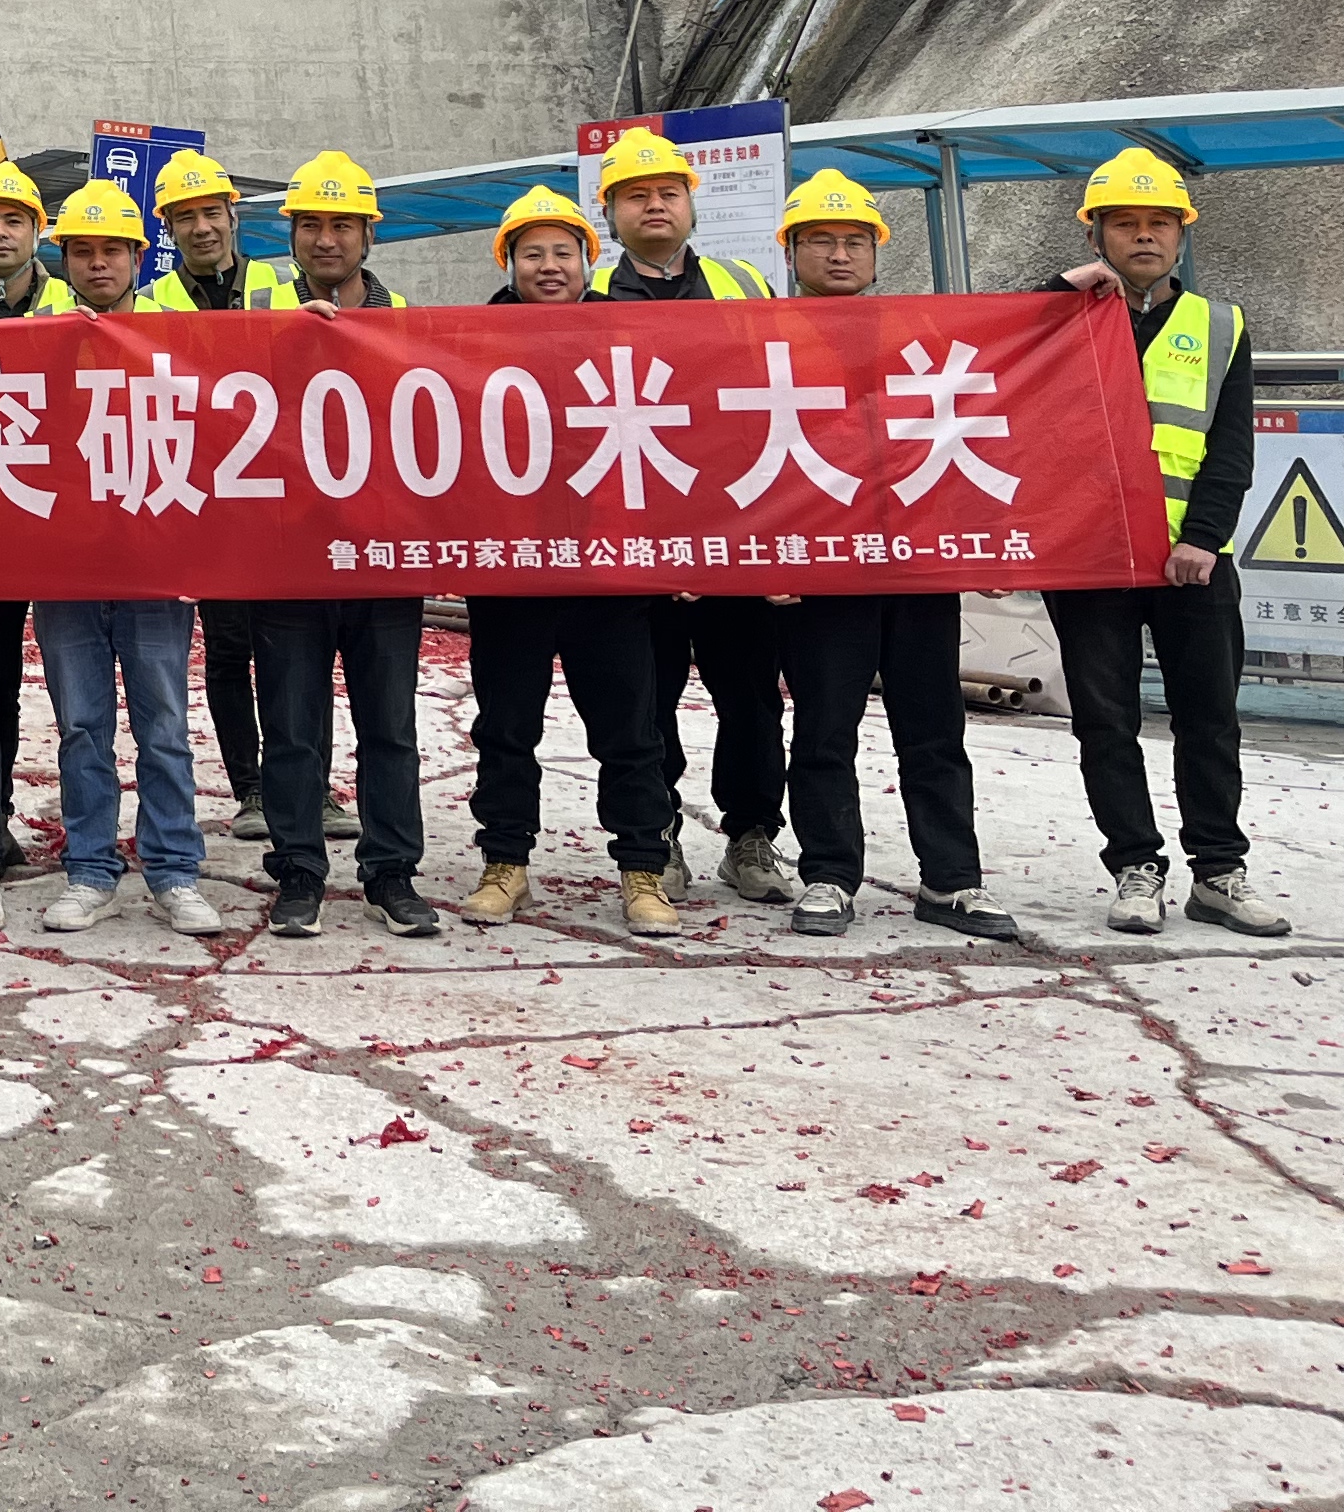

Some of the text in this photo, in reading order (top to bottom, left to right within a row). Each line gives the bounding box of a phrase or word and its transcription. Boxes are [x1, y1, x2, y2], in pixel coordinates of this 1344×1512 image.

[1167, 351, 1202, 365] YCIH
[326, 528, 1037, 572] 鲁甸至巧家高速公路项目土建工程6-5工点
